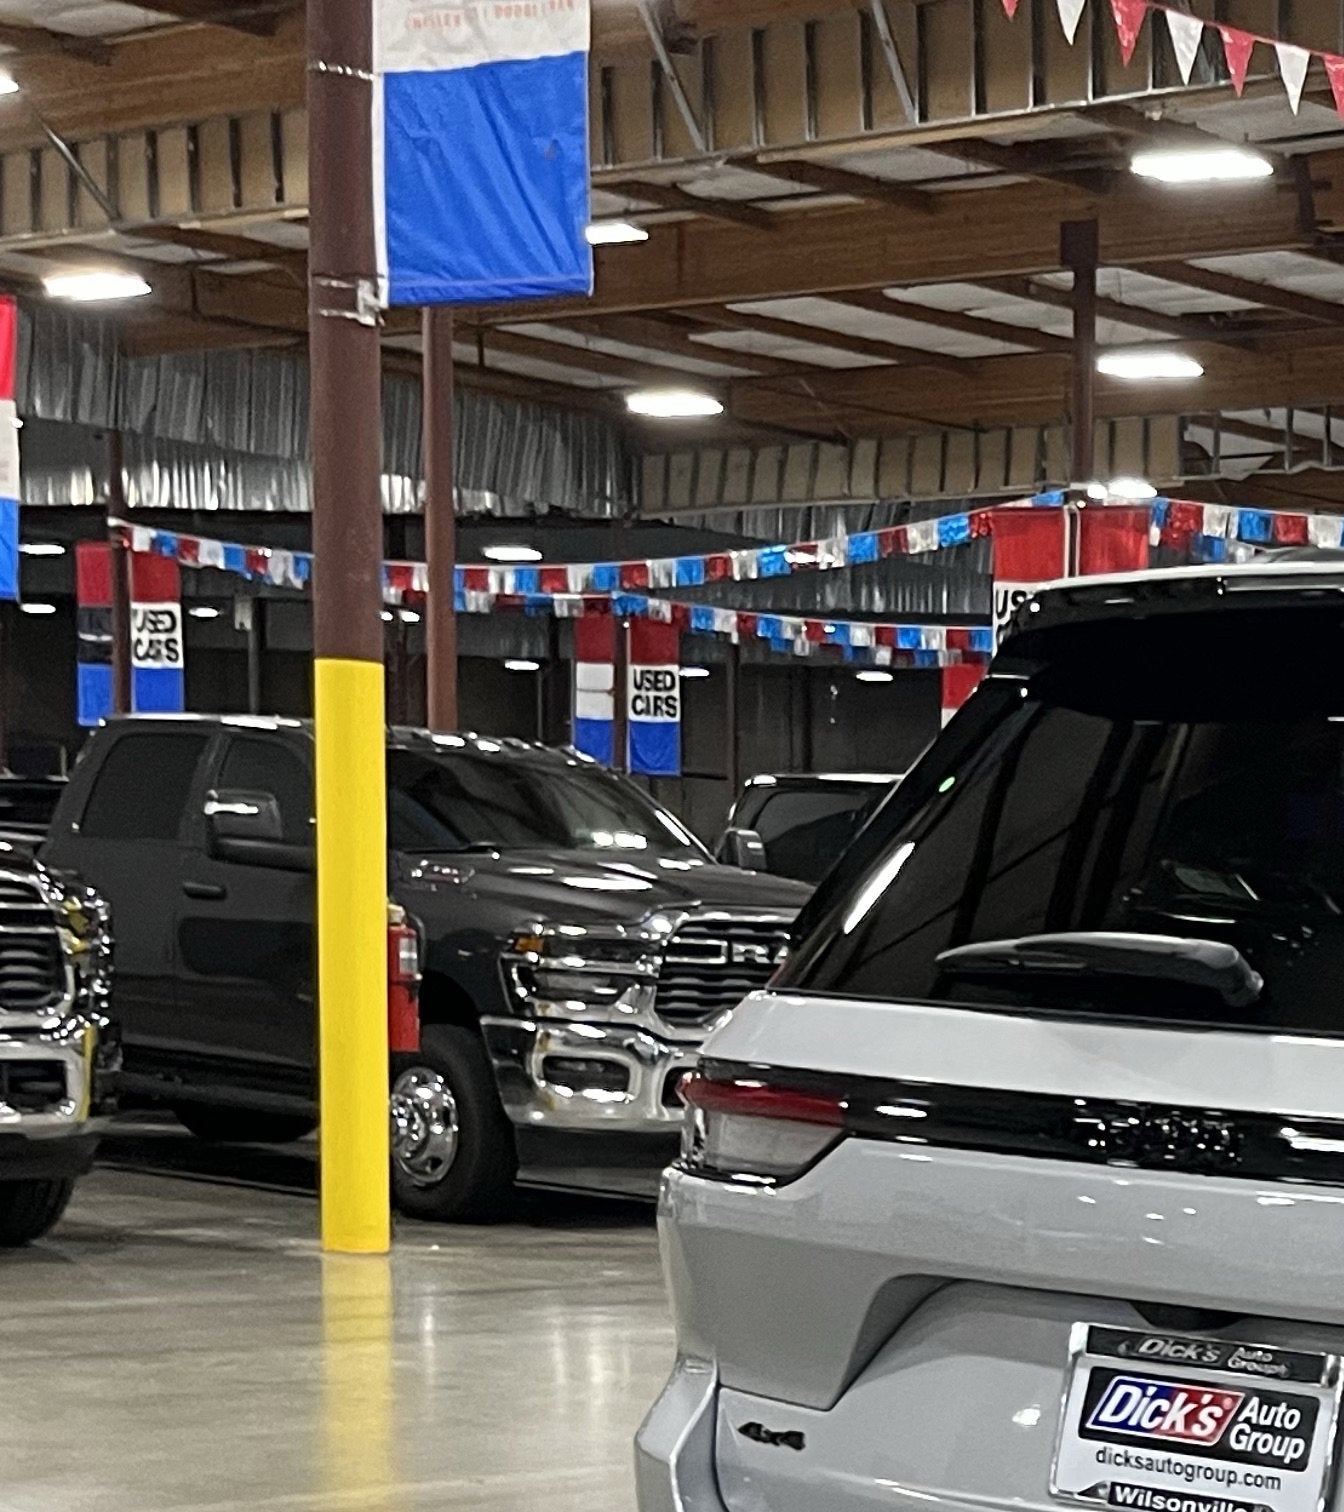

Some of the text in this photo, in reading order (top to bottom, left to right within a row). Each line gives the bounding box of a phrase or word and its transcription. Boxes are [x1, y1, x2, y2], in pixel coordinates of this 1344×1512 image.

[632, 668, 677, 692] USED
[1138, 1338, 1274, 1363] Dick's Auto
[1097, 1383, 1303, 1439] Dick's Auto
[1228, 1424, 1306, 1464] Group
[1095, 1446, 1283, 1492] dicksautogroup.com
